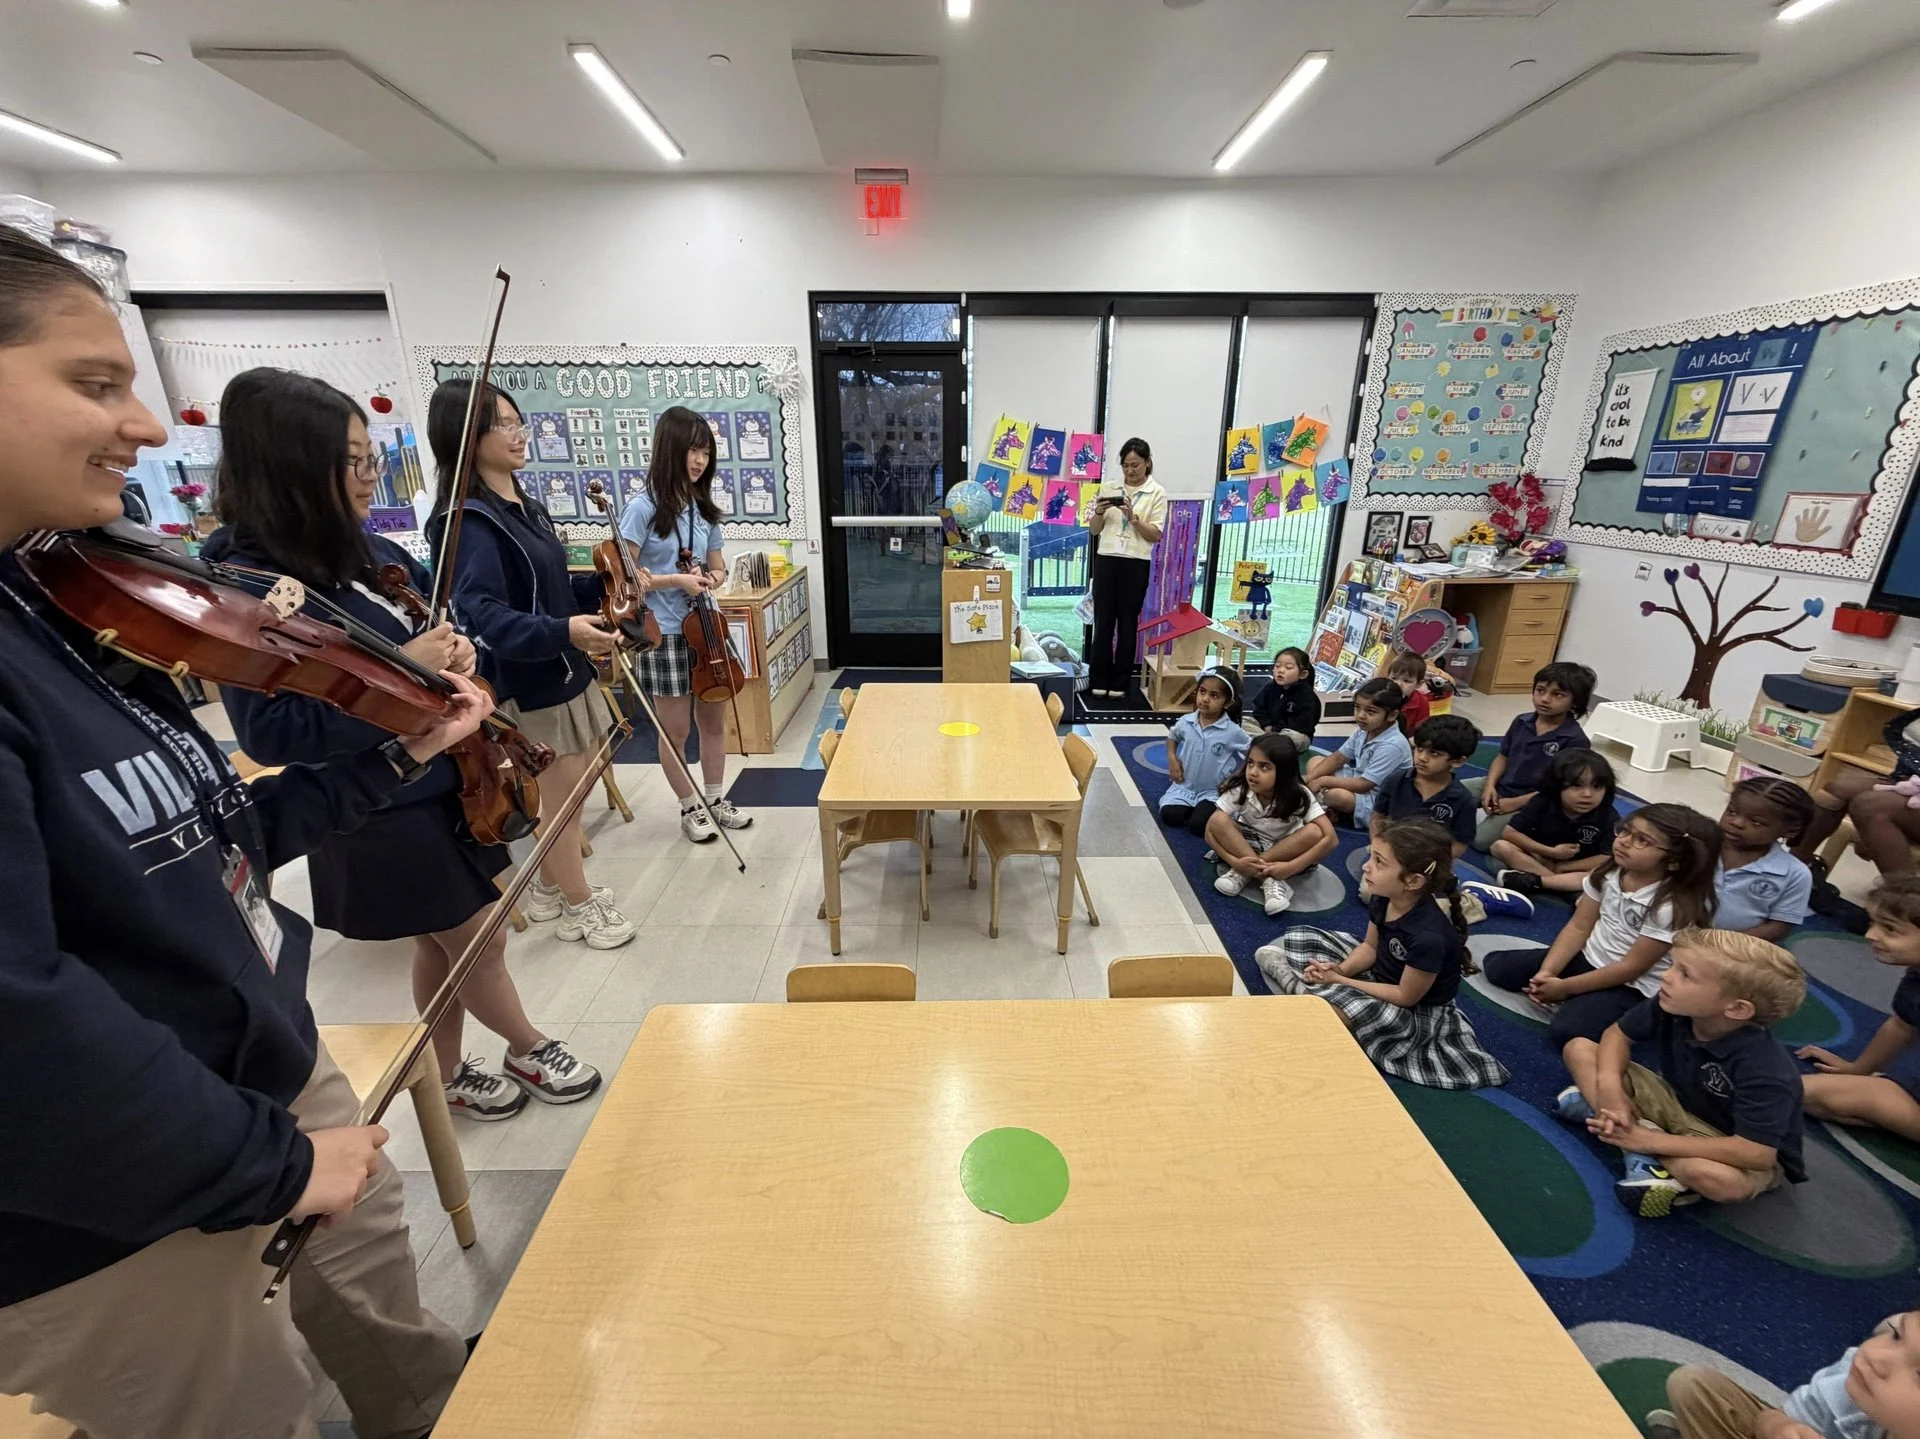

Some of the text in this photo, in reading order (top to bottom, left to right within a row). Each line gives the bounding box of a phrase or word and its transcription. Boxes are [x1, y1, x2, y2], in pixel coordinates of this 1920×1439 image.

[864, 186, 902, 219] EXIT
[1469, 298, 1497, 307] HAPPY
[1457, 307, 1506, 321] BIRTHDAY
[1399, 347, 1430, 355] JANUARY
[1453, 347, 1490, 355] FEBRUARY
[1687, 354, 1705, 370] All
[1707, 347, 1752, 367] About
[492, 370, 528, 391] YOU
[534, 370, 547, 391] A
[555, 367, 632, 399] GOOD
[1398, 387, 1419, 395] APRIL
[1452, 386, 1467, 394] MAY
[1617, 414, 1631, 428] be
[1387, 427, 1405, 435] JULY
[1440, 424, 1468, 432] AUGUST
[1483, 422, 1524, 431] SEPTEMBER
[1423, 467, 1462, 475] NOVEMBER
[1480, 467, 1518, 475] DECEMBER
[373, 517, 408, 531] Tidy Tub
[953, 604, 965, 613] The
[982, 604, 999, 612] Place
